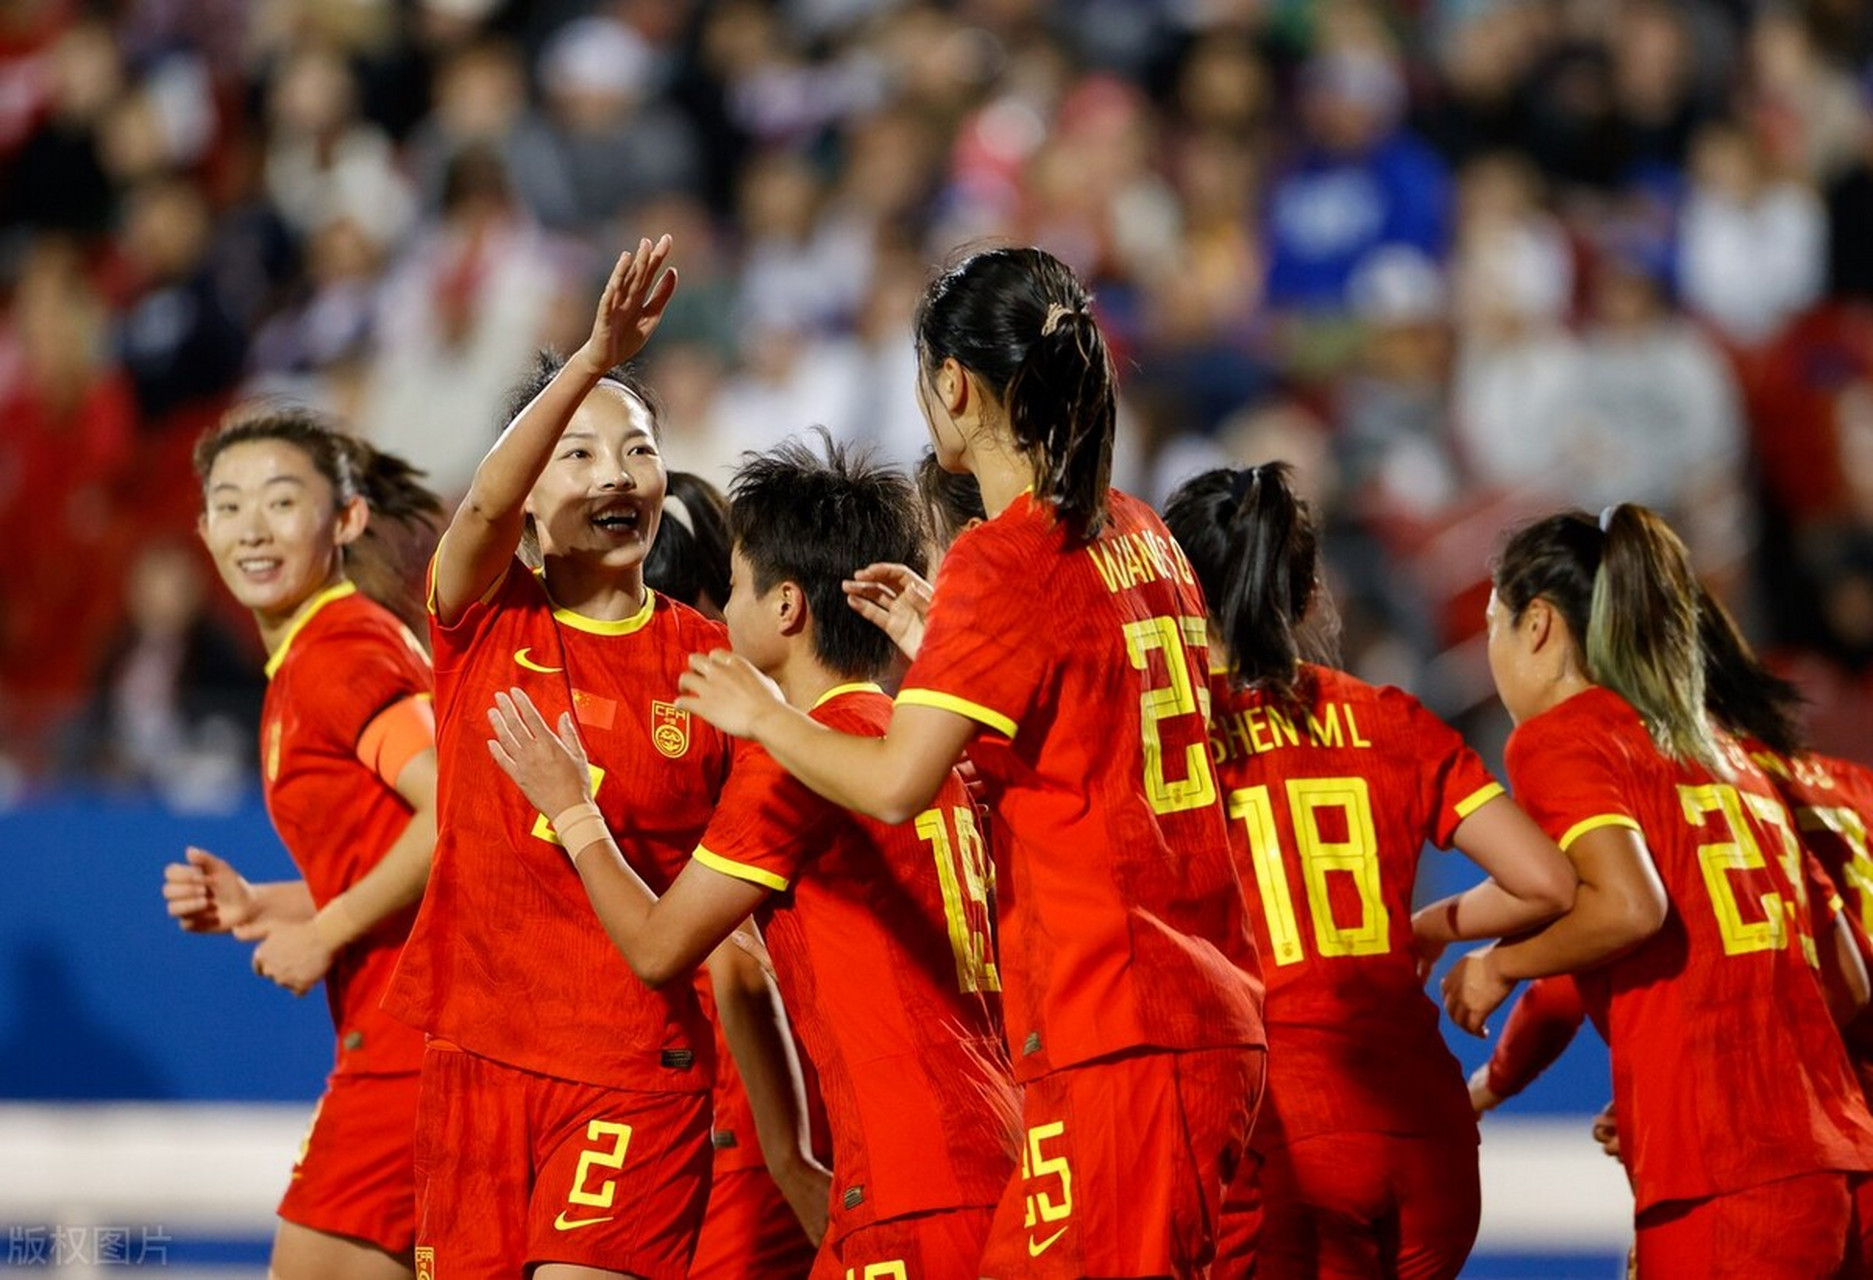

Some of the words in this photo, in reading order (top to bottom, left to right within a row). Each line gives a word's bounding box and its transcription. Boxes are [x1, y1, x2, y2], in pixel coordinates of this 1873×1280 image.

[655, 704, 686, 720] CFA
[1208, 705, 1299, 765] SHEN
[1304, 703, 1372, 748] ML
[1228, 776, 1391, 967] 18
[568, 1119, 632, 1208] 2
[1022, 1120, 1072, 1229] 5
